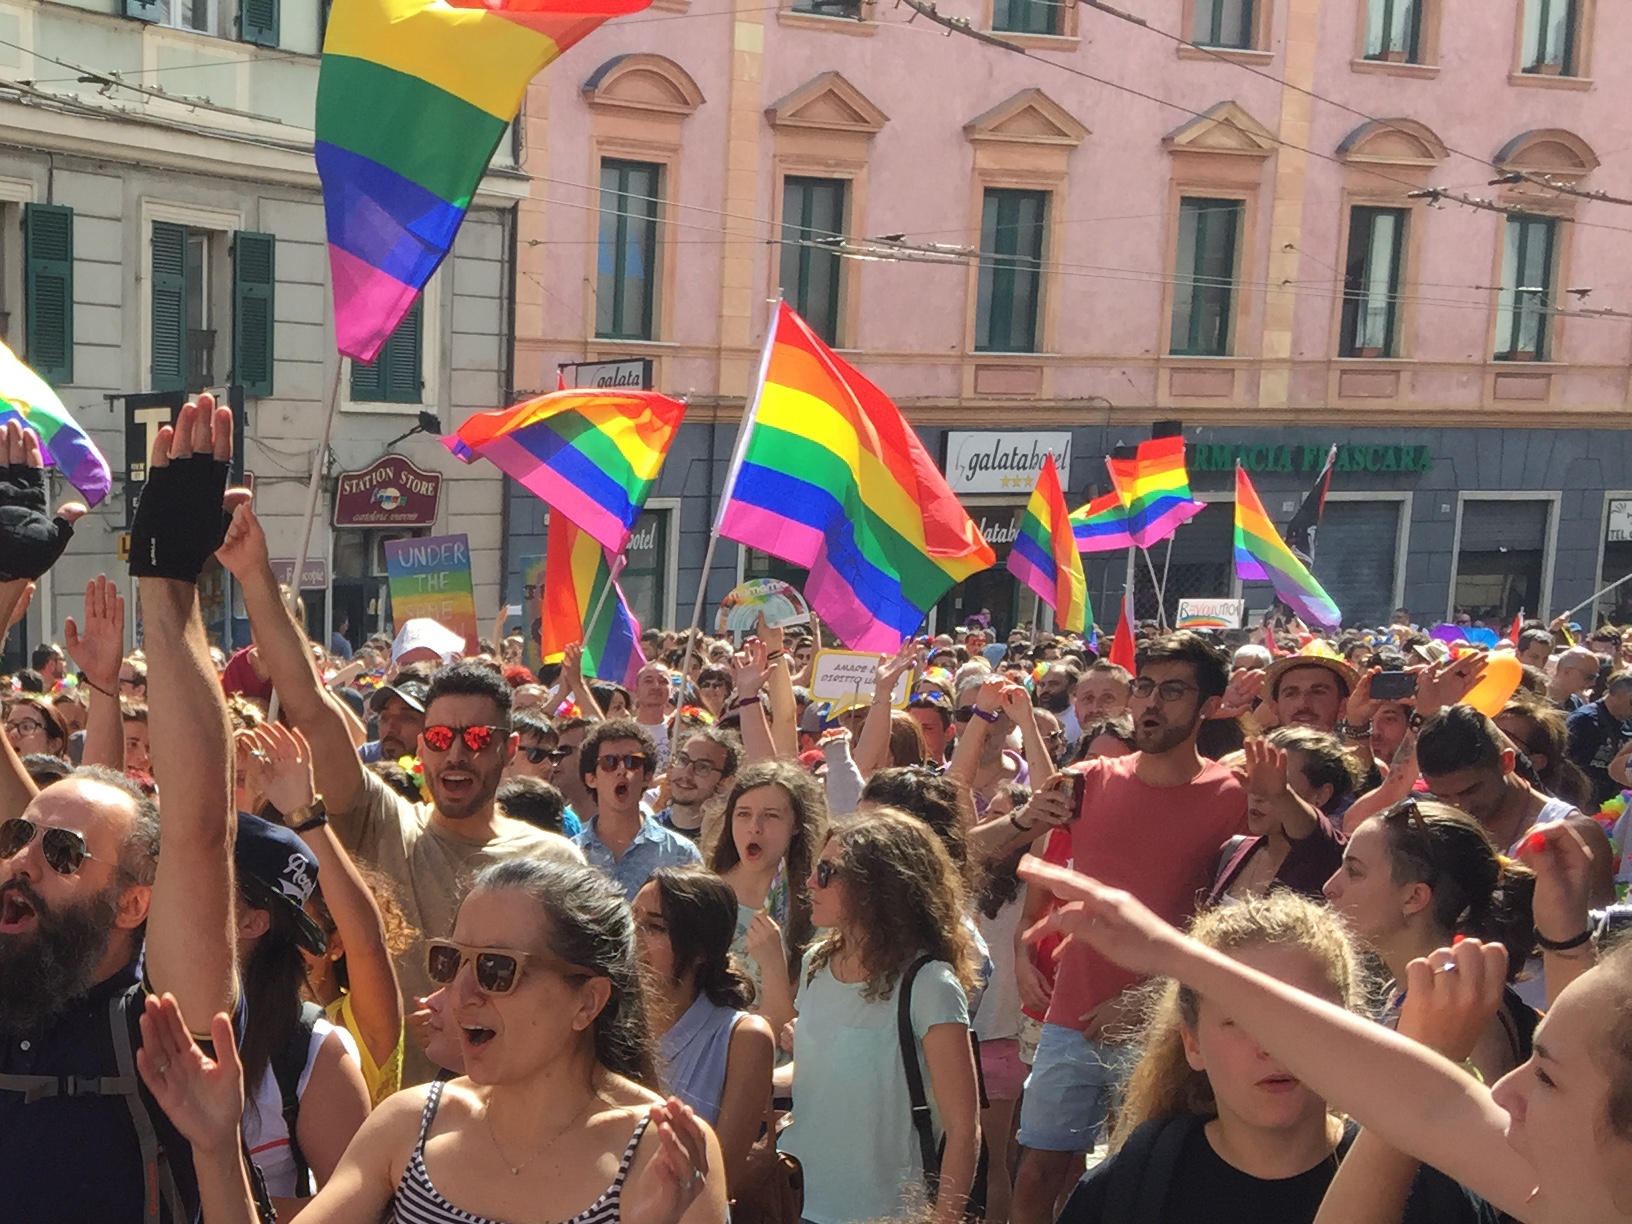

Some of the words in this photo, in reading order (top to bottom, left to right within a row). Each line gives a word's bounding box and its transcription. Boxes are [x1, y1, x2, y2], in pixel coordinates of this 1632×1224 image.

[965, 438, 1070, 482] galatahoel
[1194, 444, 1292, 472] RMACIA
[343, 466, 395, 494] STATION
[399, 471, 436, 496] STORE
[398, 541, 467, 568] UNDER
[413, 571, 449, 593] THE
[821, 674, 862, 684] DIRITTO
[833, 664, 868, 673] AMARE
